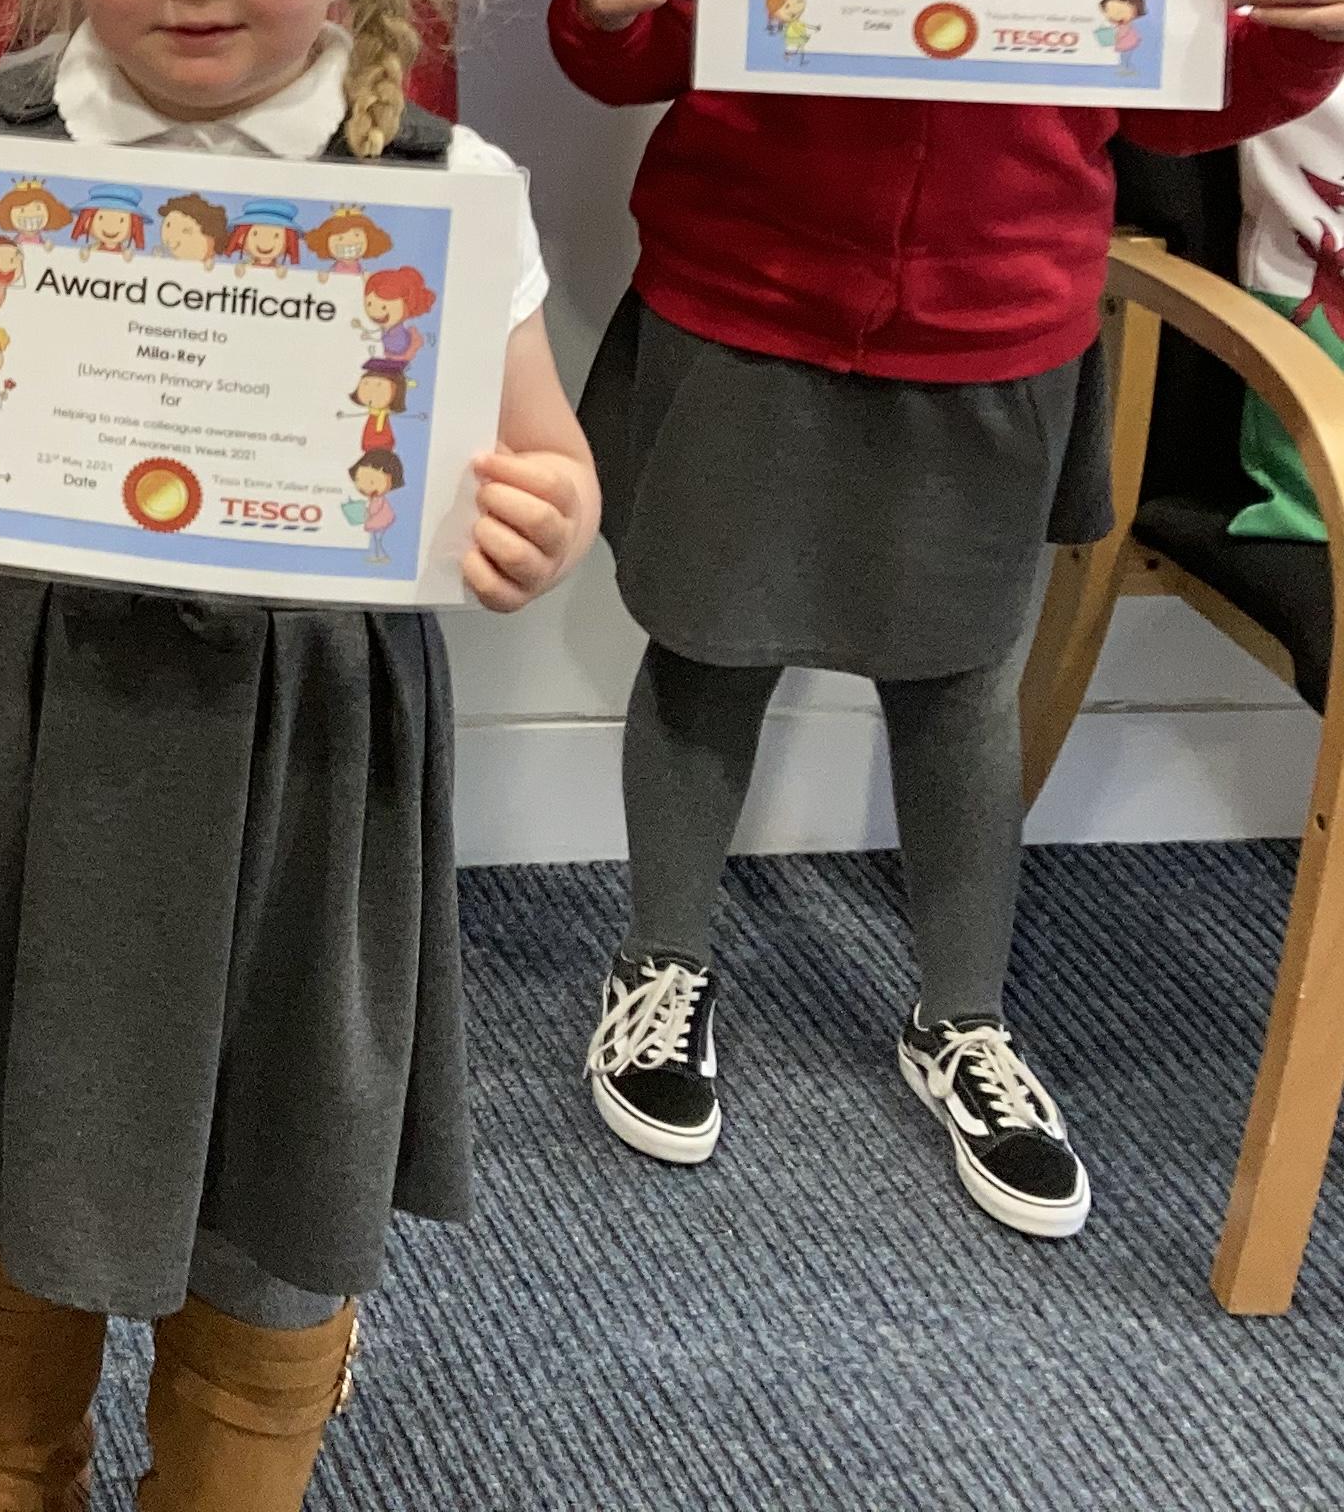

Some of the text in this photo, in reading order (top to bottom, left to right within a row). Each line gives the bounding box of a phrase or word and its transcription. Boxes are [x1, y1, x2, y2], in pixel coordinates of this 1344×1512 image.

[993, 28, 1080, 47] TESCO
[35, 267, 336, 322] Award Certificate
[127, 320, 228, 344] Presented to
[136, 344, 207, 368] Mila-Rey
[160, 372, 213, 393] Primary
[216, 379, 270, 398] School)
[159, 392, 182, 408] for
[53, 405, 98, 426] Helping
[100, 412, 111, 424] to
[270, 430, 308, 447] during
[98, 432, 127, 447] Deaf
[129, 436, 191, 455] Awareness
[231, 446, 256, 461] 2021
[64, 473, 97, 488] Date
[220, 496, 323, 524] TESCO
